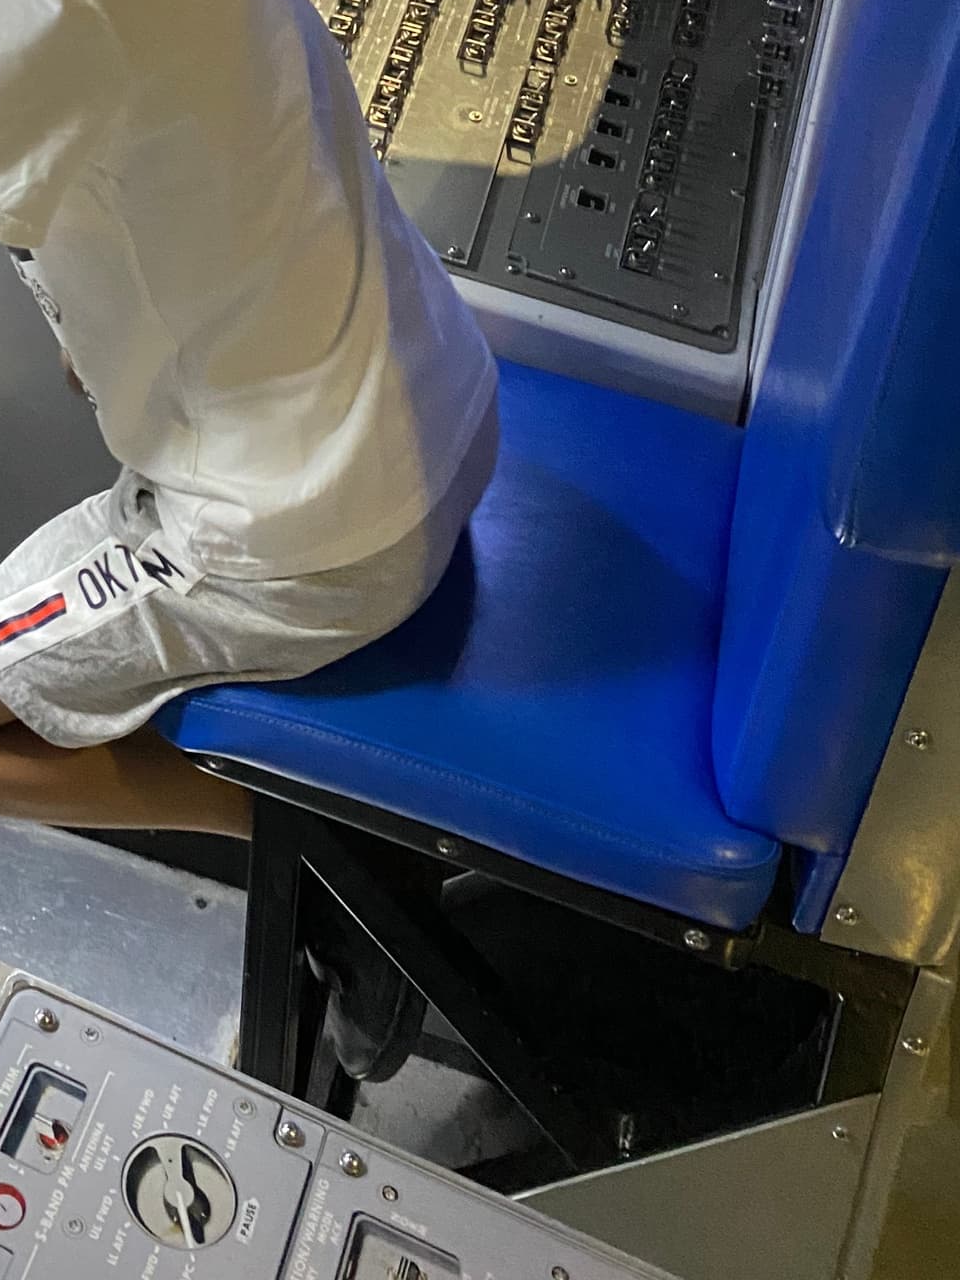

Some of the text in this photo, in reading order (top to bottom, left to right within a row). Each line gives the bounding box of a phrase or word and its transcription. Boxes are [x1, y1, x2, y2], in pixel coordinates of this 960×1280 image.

[140, 1088, 155, 1117] FWD
[203, 1087, 219, 1114] FWD
[79, 1121, 105, 1173] ANTENNA
[94, 1134, 116, 1172] UL AFT
[34, 1164, 76, 1243] S-BAND PM
[89, 1195, 114, 1241] UL FWD
[241, 1202, 258, 1238] PAUSE
[106, 1227, 128, 1267] LL AFT
